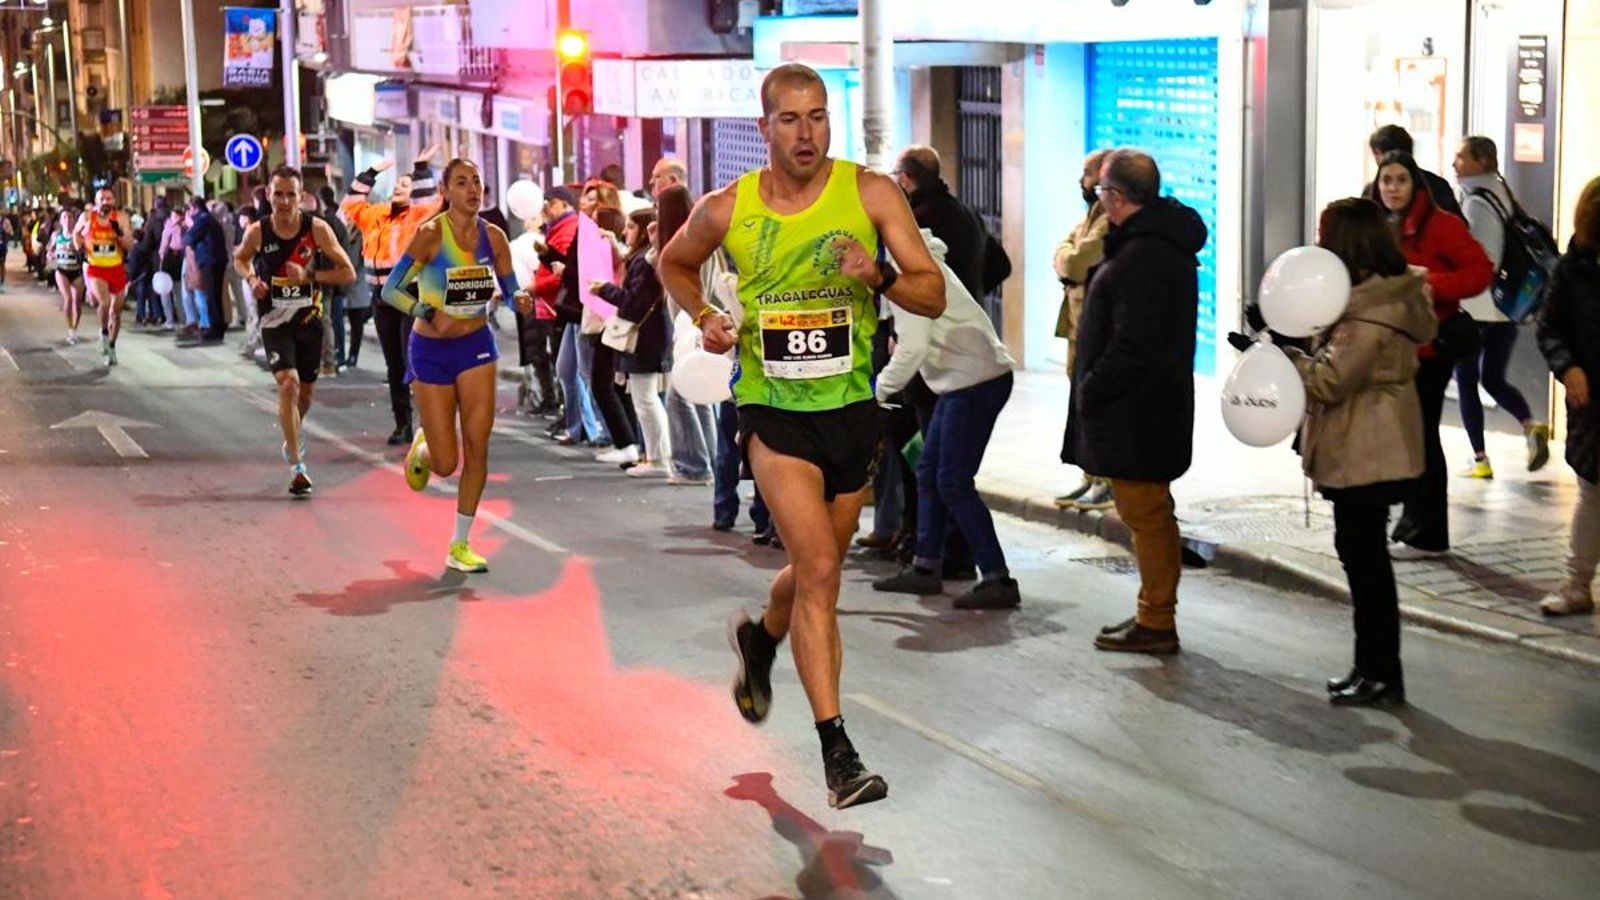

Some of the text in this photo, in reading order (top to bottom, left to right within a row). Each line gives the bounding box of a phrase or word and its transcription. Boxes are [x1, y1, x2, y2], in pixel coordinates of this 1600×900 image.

[651, 87, 757, 102] AMRICA
[281, 286, 301, 297] 92
[464, 291, 477, 301] 34
[755, 286, 854, 305] TRAGALEGUAS
[787, 329, 828, 355] 86
